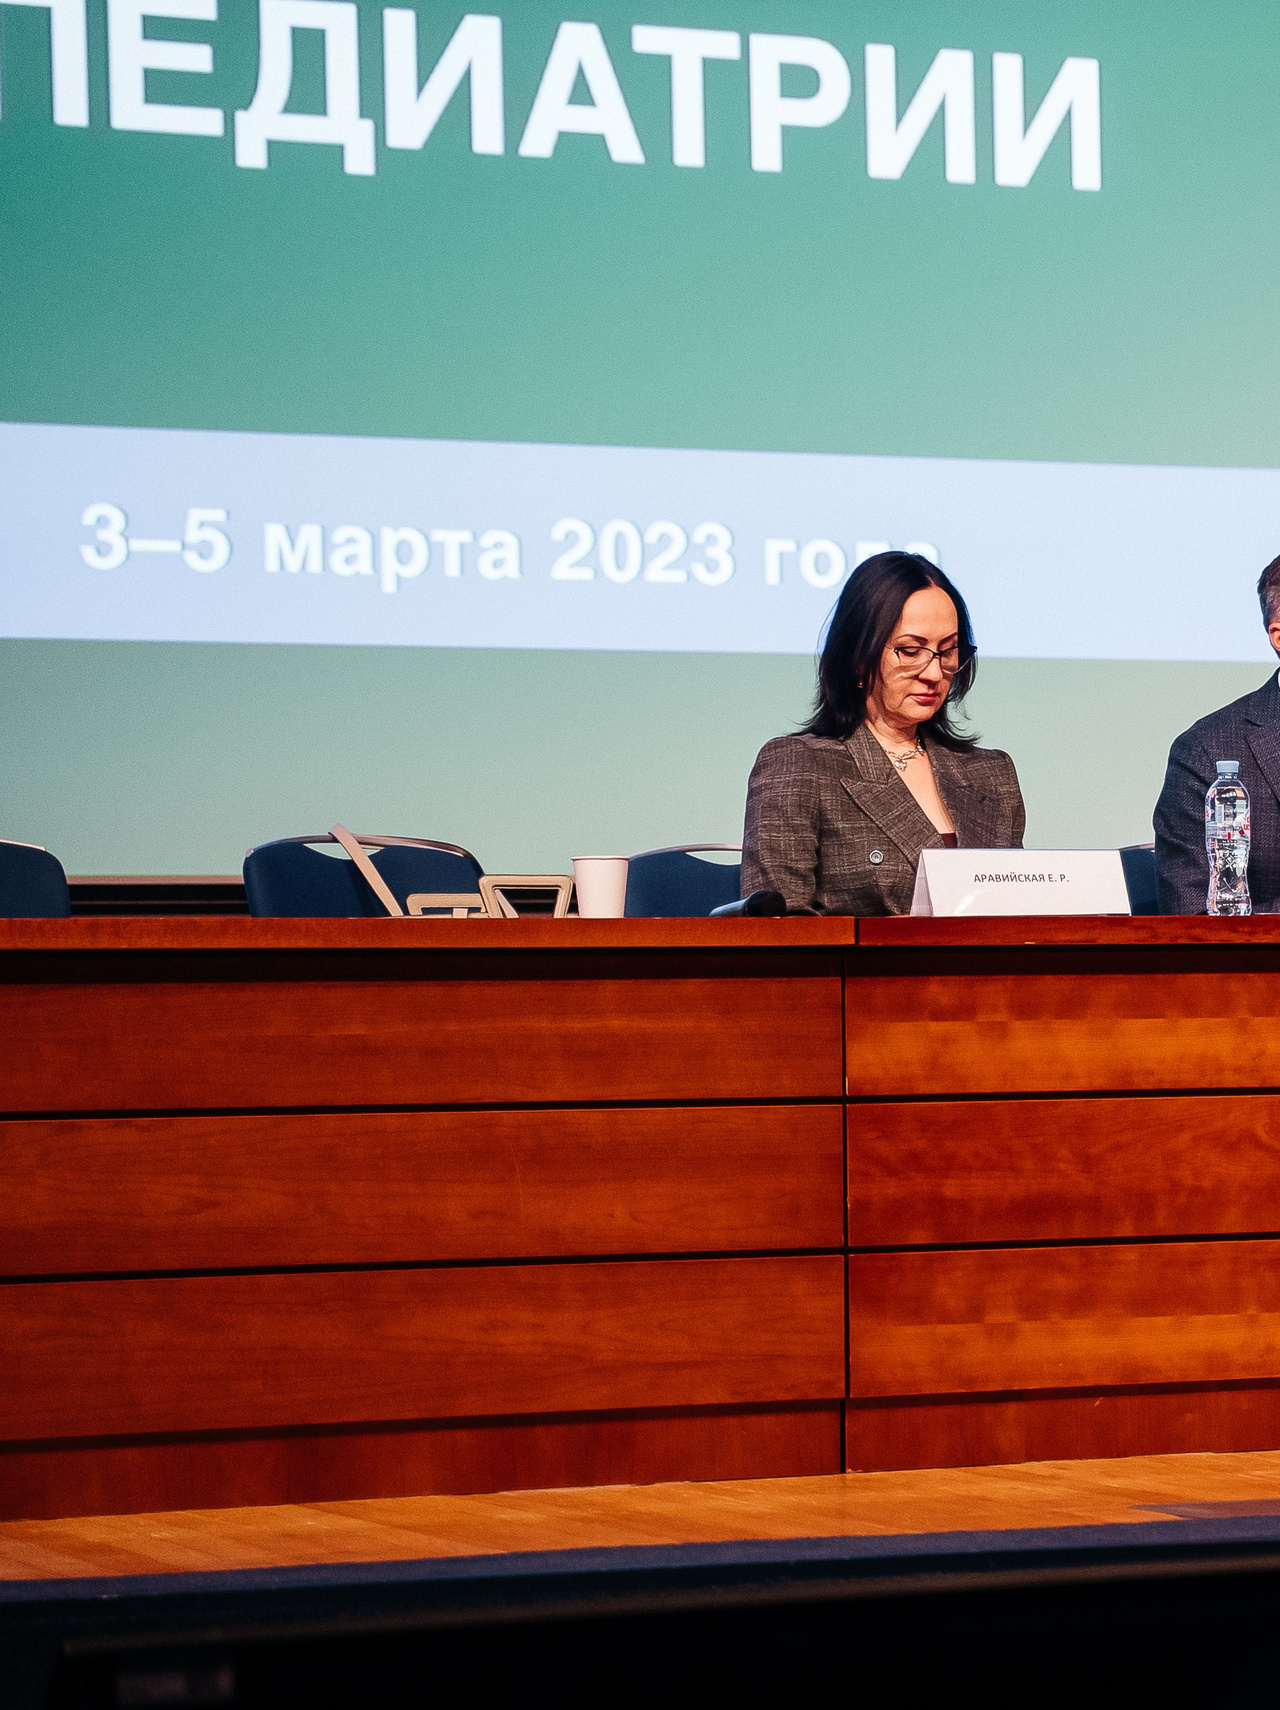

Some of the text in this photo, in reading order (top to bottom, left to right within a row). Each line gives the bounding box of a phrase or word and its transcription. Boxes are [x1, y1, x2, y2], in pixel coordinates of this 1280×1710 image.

[263, 521, 523, 594] марта
[549, 516, 737, 587] 2023
[973, 872, 1070, 883] АРАВИЙСКАЯ Е. Р.
